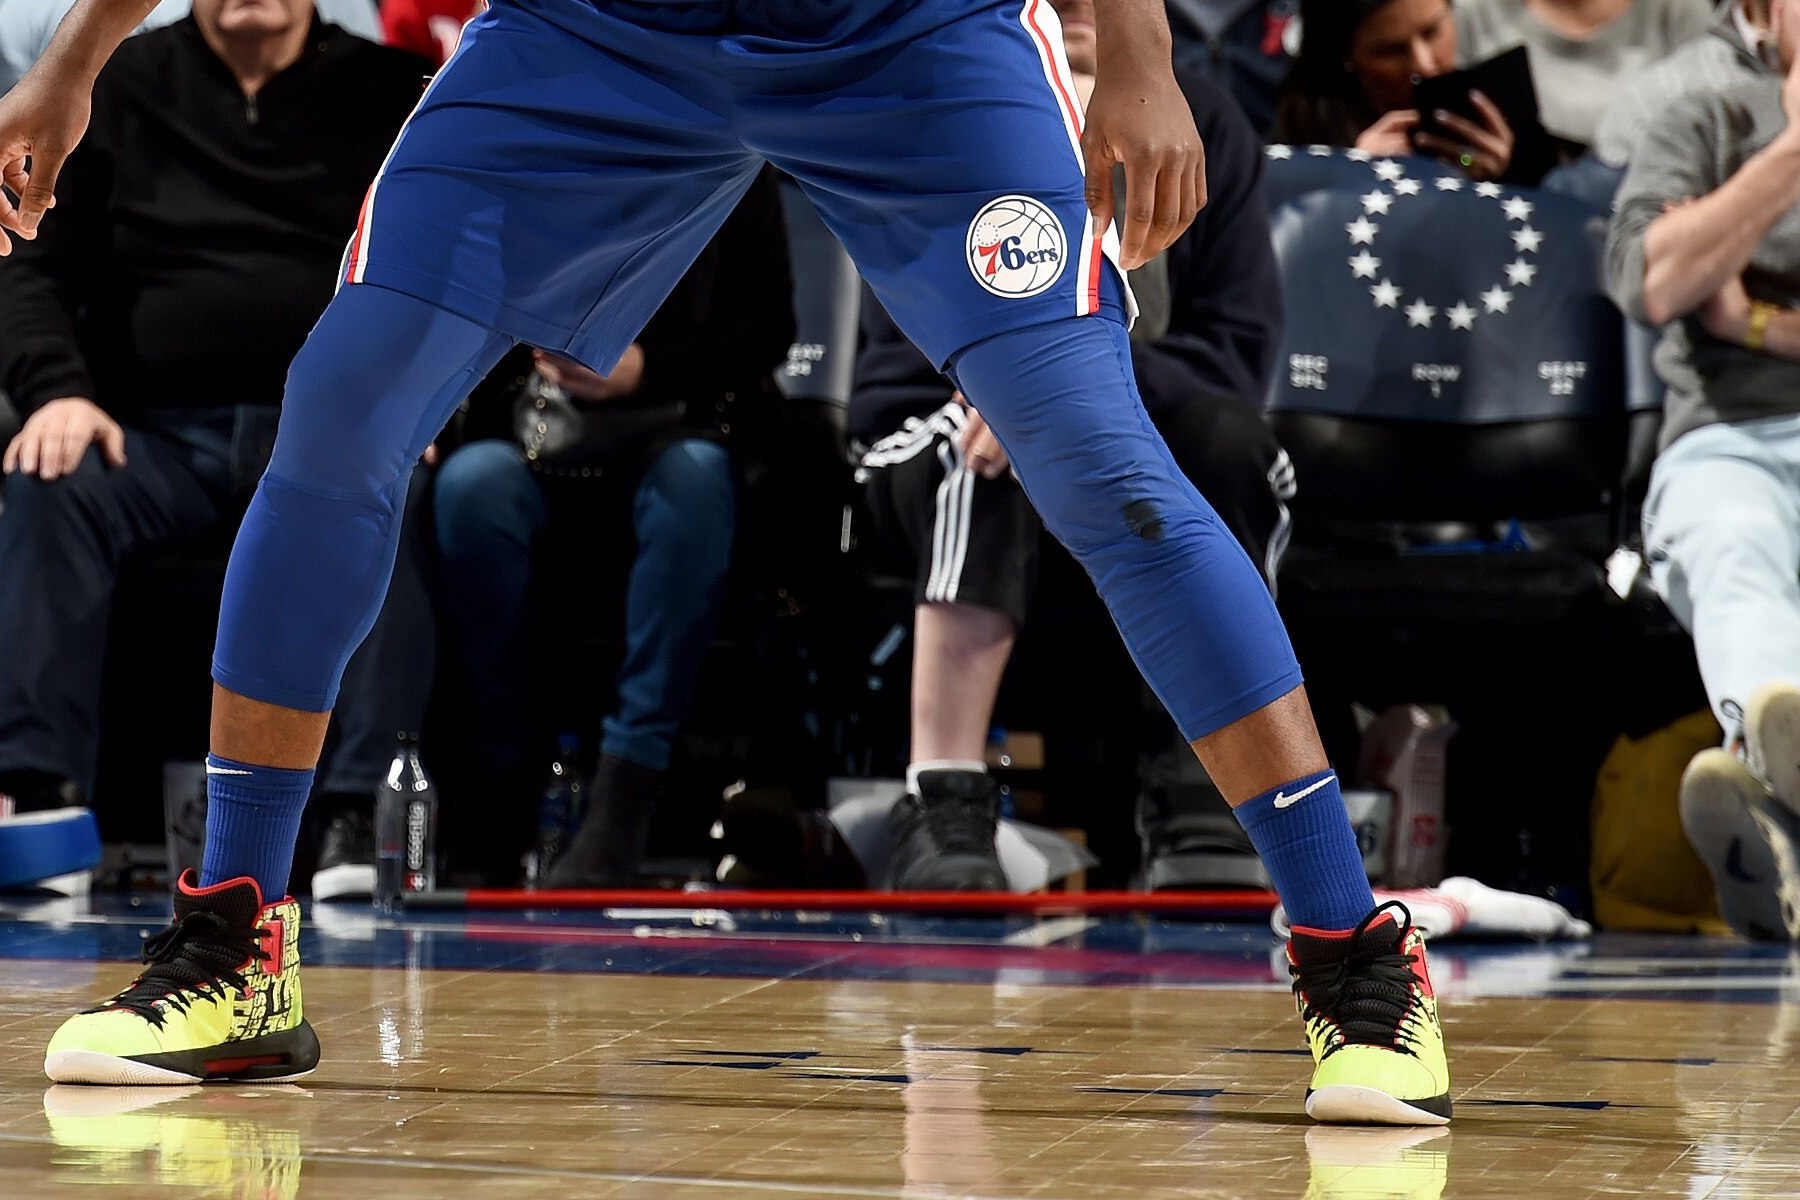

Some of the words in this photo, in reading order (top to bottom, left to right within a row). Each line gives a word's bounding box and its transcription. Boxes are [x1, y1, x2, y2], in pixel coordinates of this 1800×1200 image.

[977, 234, 1059, 277] 76ers
[787, 343, 827, 361] EAT
[1412, 363, 1461, 382] ROW
[1538, 361, 1588, 379] SEAT
